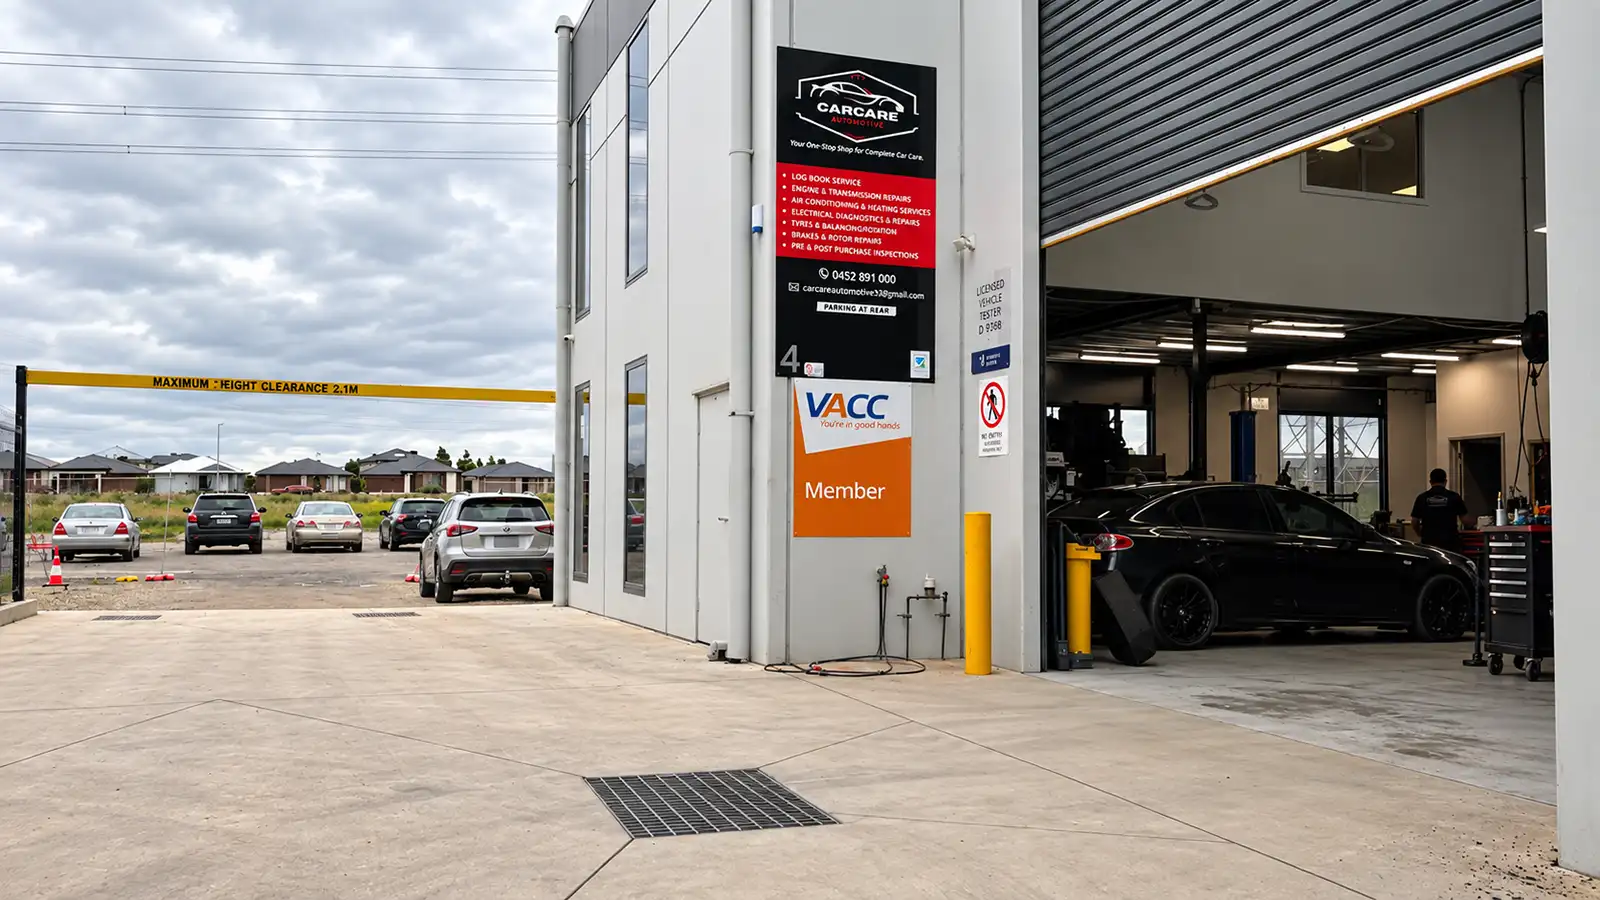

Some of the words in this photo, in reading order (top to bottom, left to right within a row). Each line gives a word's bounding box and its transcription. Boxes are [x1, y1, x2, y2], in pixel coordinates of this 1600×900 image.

[817, 103, 899, 122] CARCARE
[831, 117, 884, 128] AUTOMOTIVE
[806, 142, 836, 151] One-Stop
[837, 145, 853, 154] Shop
[865, 148, 895, 158] Complete
[908, 153, 923, 161] Care.
[792, 173, 806, 181] LOG
[809, 175, 830, 183] BOOK
[832, 177, 861, 186] SERVICE
[792, 185, 819, 194] ENGINE
[829, 188, 881, 200] TRANSMISSION
[883, 193, 911, 202] REPAIRS
[805, 198, 859, 209] CONDITIONING
[868, 204, 898, 213] HEATING
[900, 207, 931, 216] SERVICES
[792, 209, 833, 219] ELECTRICAL
[836, 213, 883, 223] DIAGNOSTICS
[893, 218, 920, 226] REPAIRS
[792, 220, 813, 228] TYRES
[792, 232, 819, 240] BRAKES
[829, 235, 852, 243] ROTOR
[854, 237, 882, 245] REPAIRS
[835, 246, 871, 255] PURCHASE
[874, 249, 918, 259] INSPECTIONS
[832, 271, 856, 281] 0452
[859, 272, 875, 282] 891
[878, 274, 896, 284] 000
[977, 279, 1004, 296] LICENSED
[824, 304, 856, 312] PARKING
[979, 293, 1002, 308] VEHICLE
[980, 307, 1001, 320] TESTER
[979, 324, 984, 336] D
[780, 345, 800, 373] 4
[153, 377, 209, 388] MAXIMUM
[261, 382, 328, 393] CLEARANCE
[333, 385, 358, 394] 2.1M
[806, 392, 889, 419] VACC
[821, 420, 843, 428] You're
[855, 422, 875, 430] good
[806, 482, 885, 500] Member
